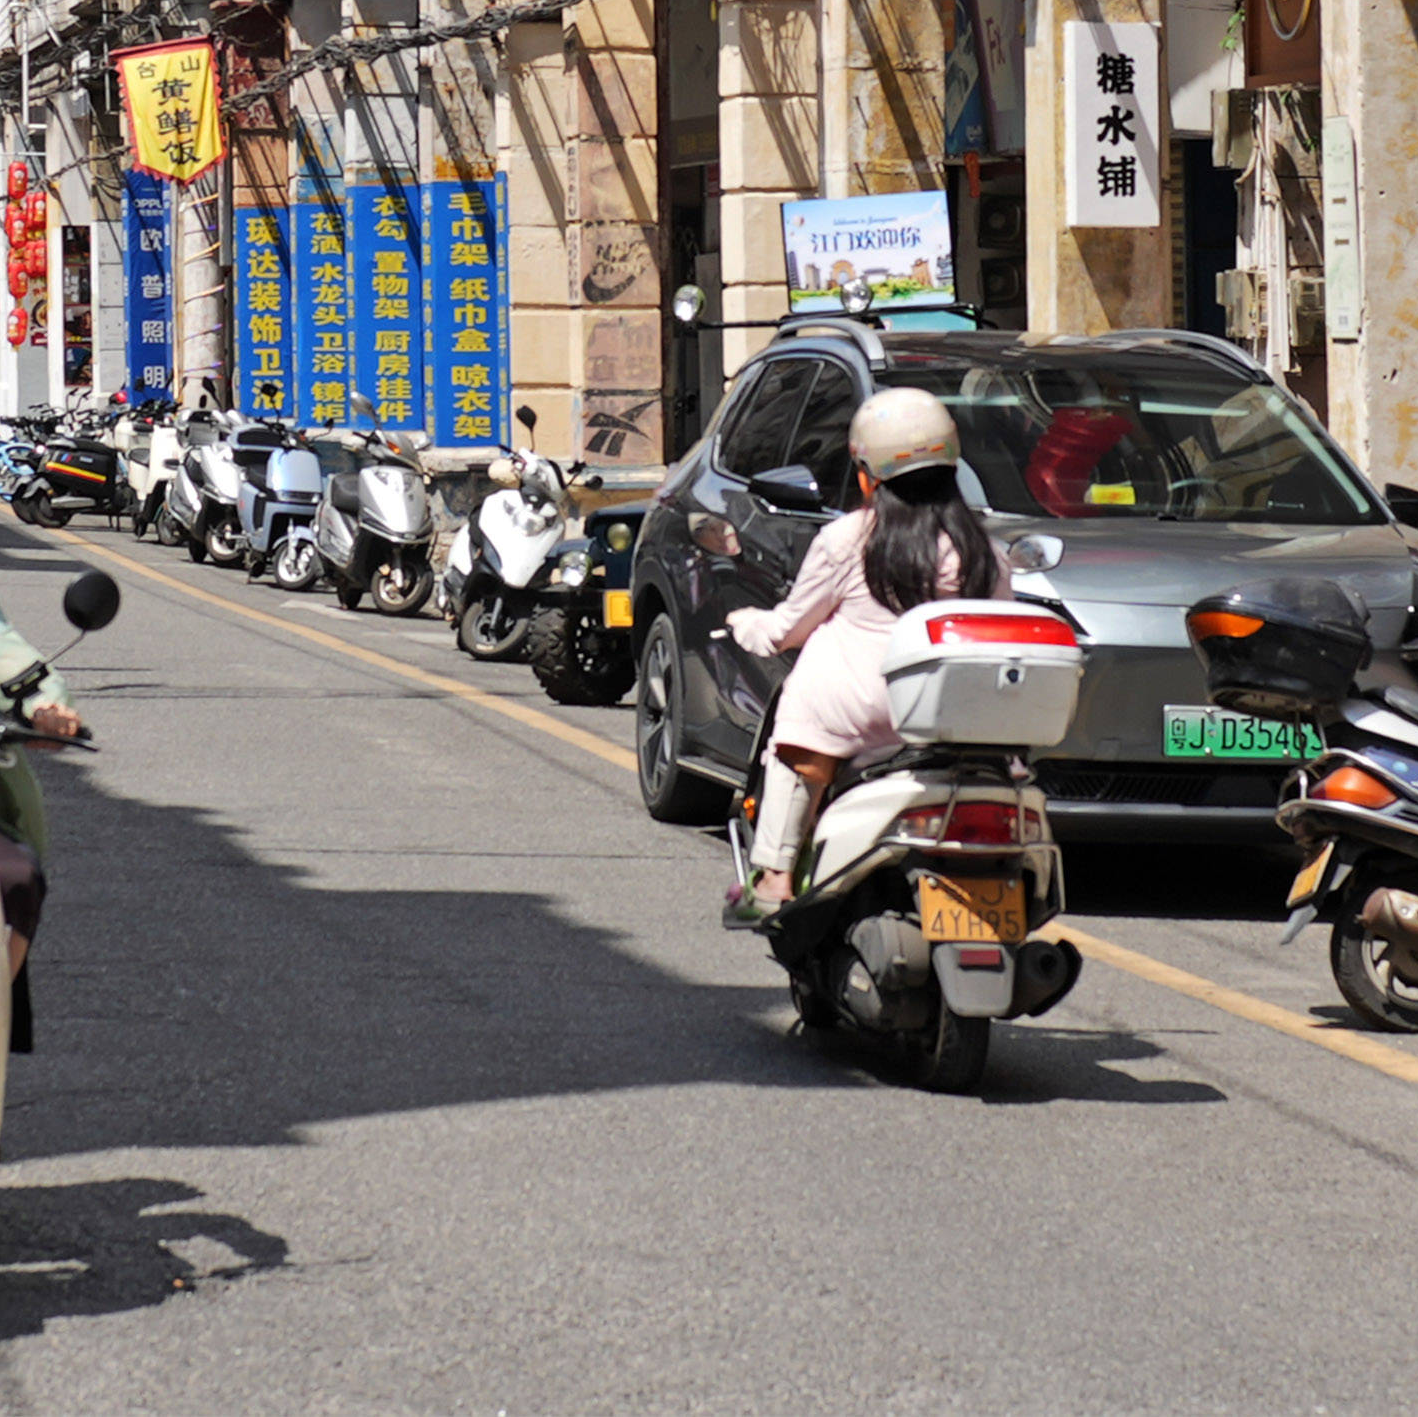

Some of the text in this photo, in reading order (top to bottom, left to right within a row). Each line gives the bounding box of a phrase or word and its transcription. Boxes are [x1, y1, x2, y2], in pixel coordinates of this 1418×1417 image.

[136, 54, 201, 79] 台山
[151, 77, 202, 166] 黄鳝饭
[1097, 52, 1136, 197] 糖水铺
[139, 226, 167, 388] 欧普照明
[371, 195, 413, 423] 衣勾 置物架 厨房挂件
[811, 227, 921, 253] 江门欢迎你
[310, 212, 347, 424] 花洒 水龙头 卫浴 镜柜
[448, 192, 493, 439] 毛巾架 纸巾盒 晾衣架
[931, 910, 1020, 938] 4YH95
